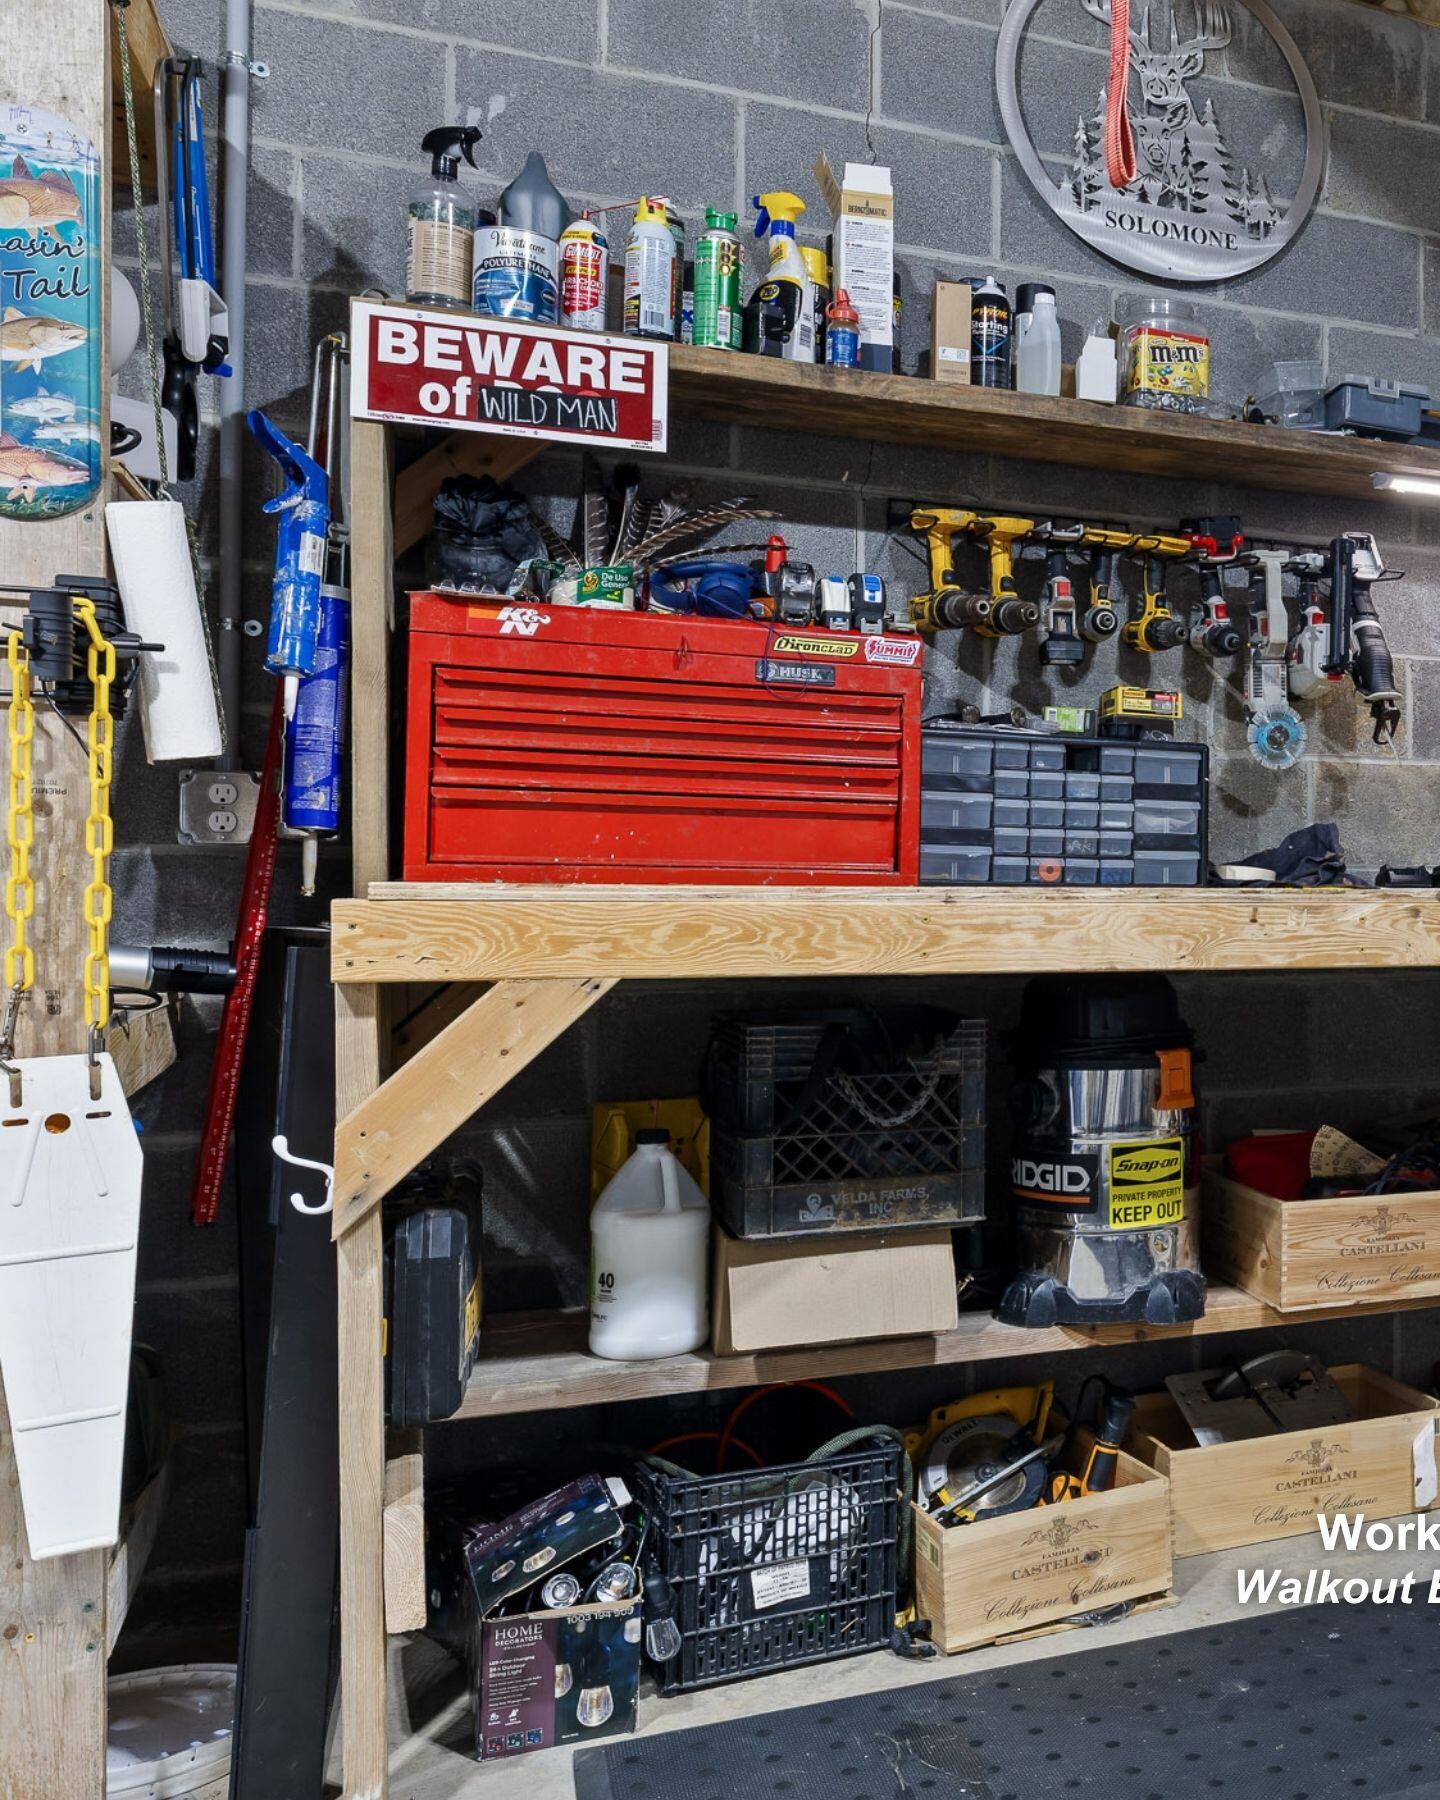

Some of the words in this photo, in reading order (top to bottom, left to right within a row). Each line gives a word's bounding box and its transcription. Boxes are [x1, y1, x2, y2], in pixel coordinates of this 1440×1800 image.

[1105, 210, 1238, 251] SOLOMONE
[0, 231, 85, 258] asin'
[483, 257, 552, 279] POLYURETHANE
[3, 265, 90, 300] Tail
[971, 320, 1008, 335] Starting
[377, 319, 646, 395] BEWARE
[418, 376, 473, 417] of
[481, 387, 547, 425] WILD
[556, 397, 618, 433] MAN
[601, 572, 613, 581] De
[496, 606, 551, 636] K&N
[1115, 1157, 1179, 1173] Snap-on
[1112, 1190, 1146, 1203] PRIVATE
[1147, 1186, 1182, 1200] PROPERTY
[1112, 1204, 1153, 1224] KEEP
[1157, 1200, 1182, 1219] OUT
[1340, 1240, 1426, 1258] CASTELLANI
[598, 1271, 615, 1289] 40
[1313, 1270, 1380, 1294] Collezione
[1276, 1470, 1358, 1492] CASTELLANI
[1253, 1504, 1314, 1526] Collezione
[1321, 1492, 1379, 1512] Collesano
[1042, 1546, 1080, 1560] FAMIGLIA
[984, 1595, 1060, 1621] Collezione
[1067, 1575, 1136, 1599] Collesano
[494, 1635, 544, 1647] DECORATORS
[495, 1622, 544, 1640] HOME
